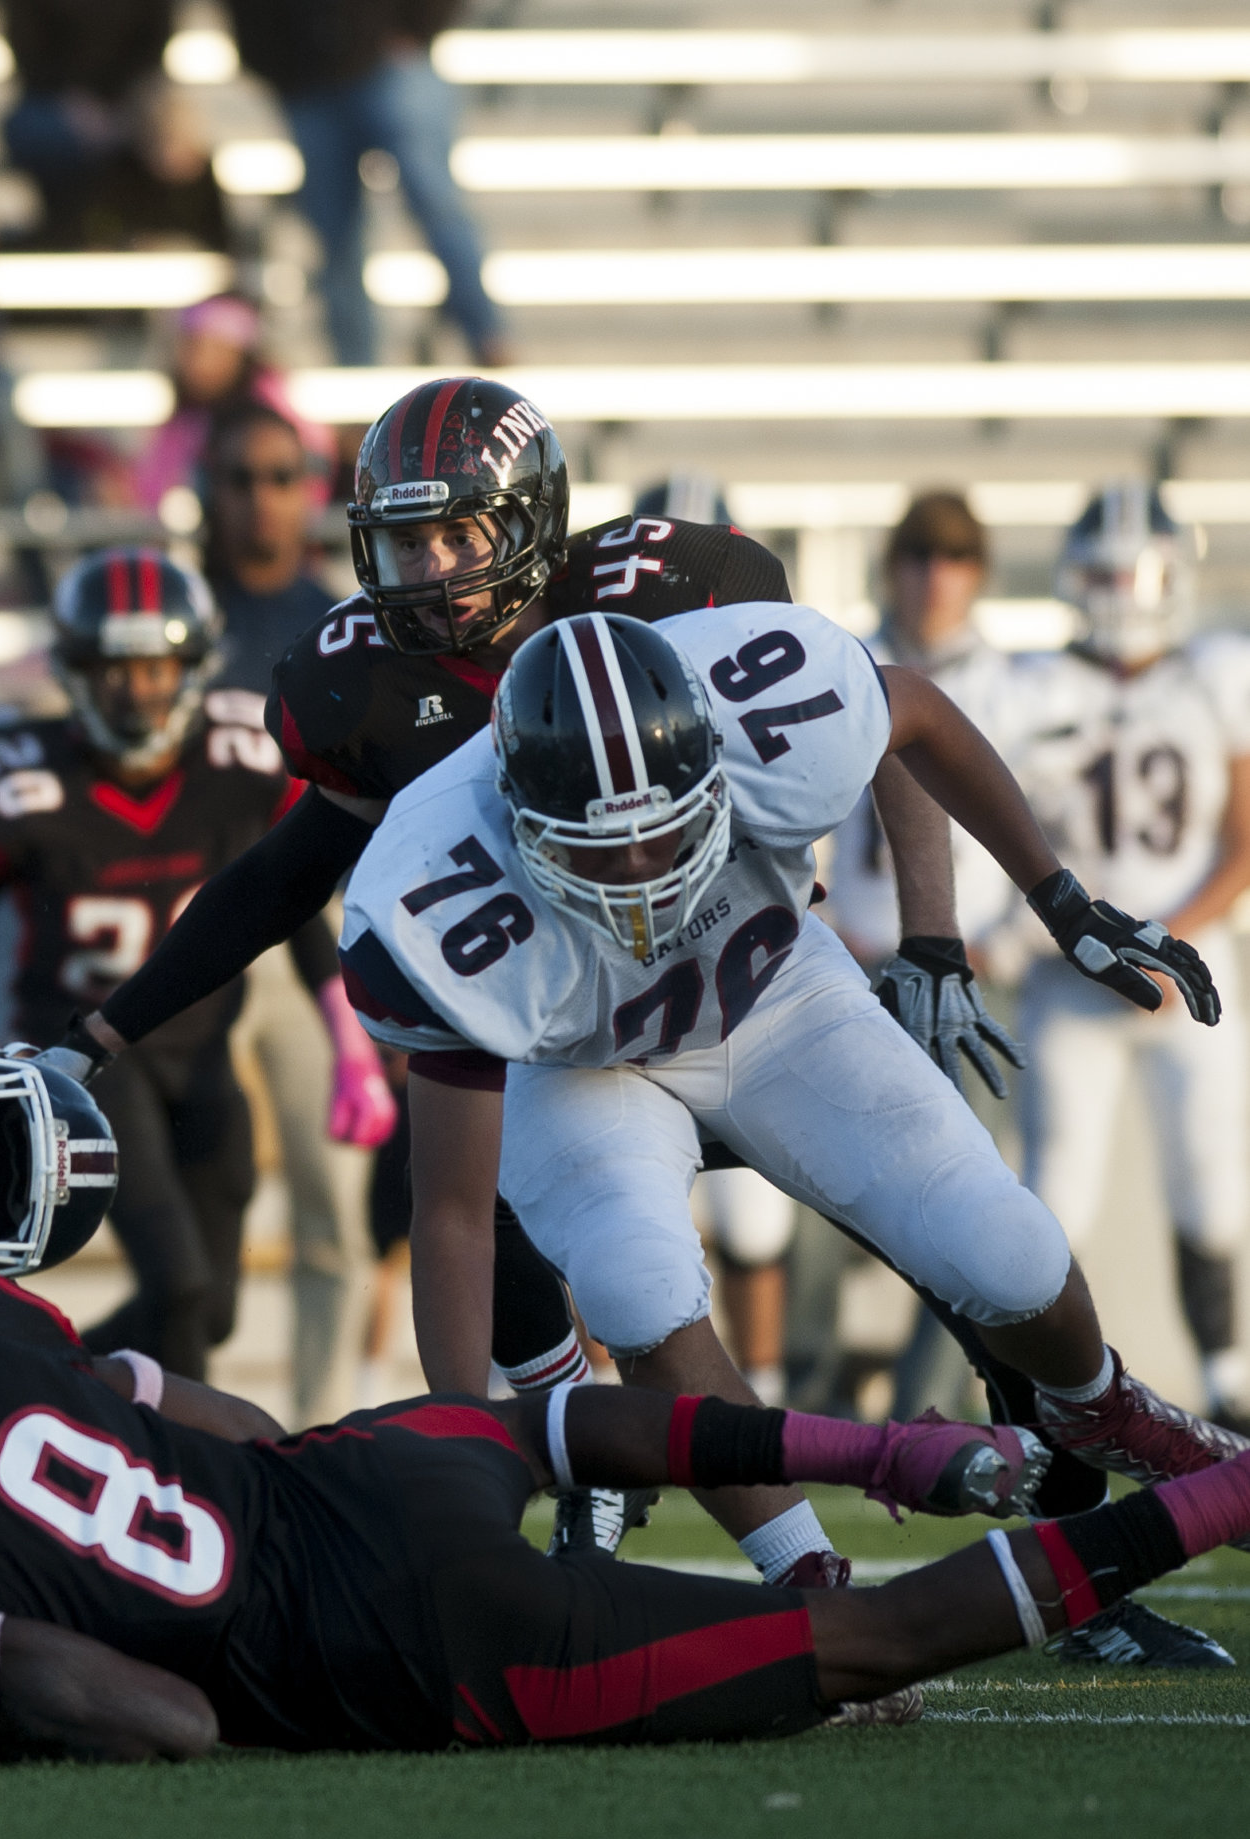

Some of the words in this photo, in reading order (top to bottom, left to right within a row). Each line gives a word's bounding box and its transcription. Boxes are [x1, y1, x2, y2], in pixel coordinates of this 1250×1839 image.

[480, 400, 554, 490] LINK
[392, 485, 431, 500] Riddell
[591, 518, 675, 602] 45
[709, 628, 846, 765] 76
[605, 794, 652, 813] Riddell
[1080, 742, 1190, 858] 13
[401, 834, 536, 977] 76
[56, 1140, 68, 1187] Riddell
